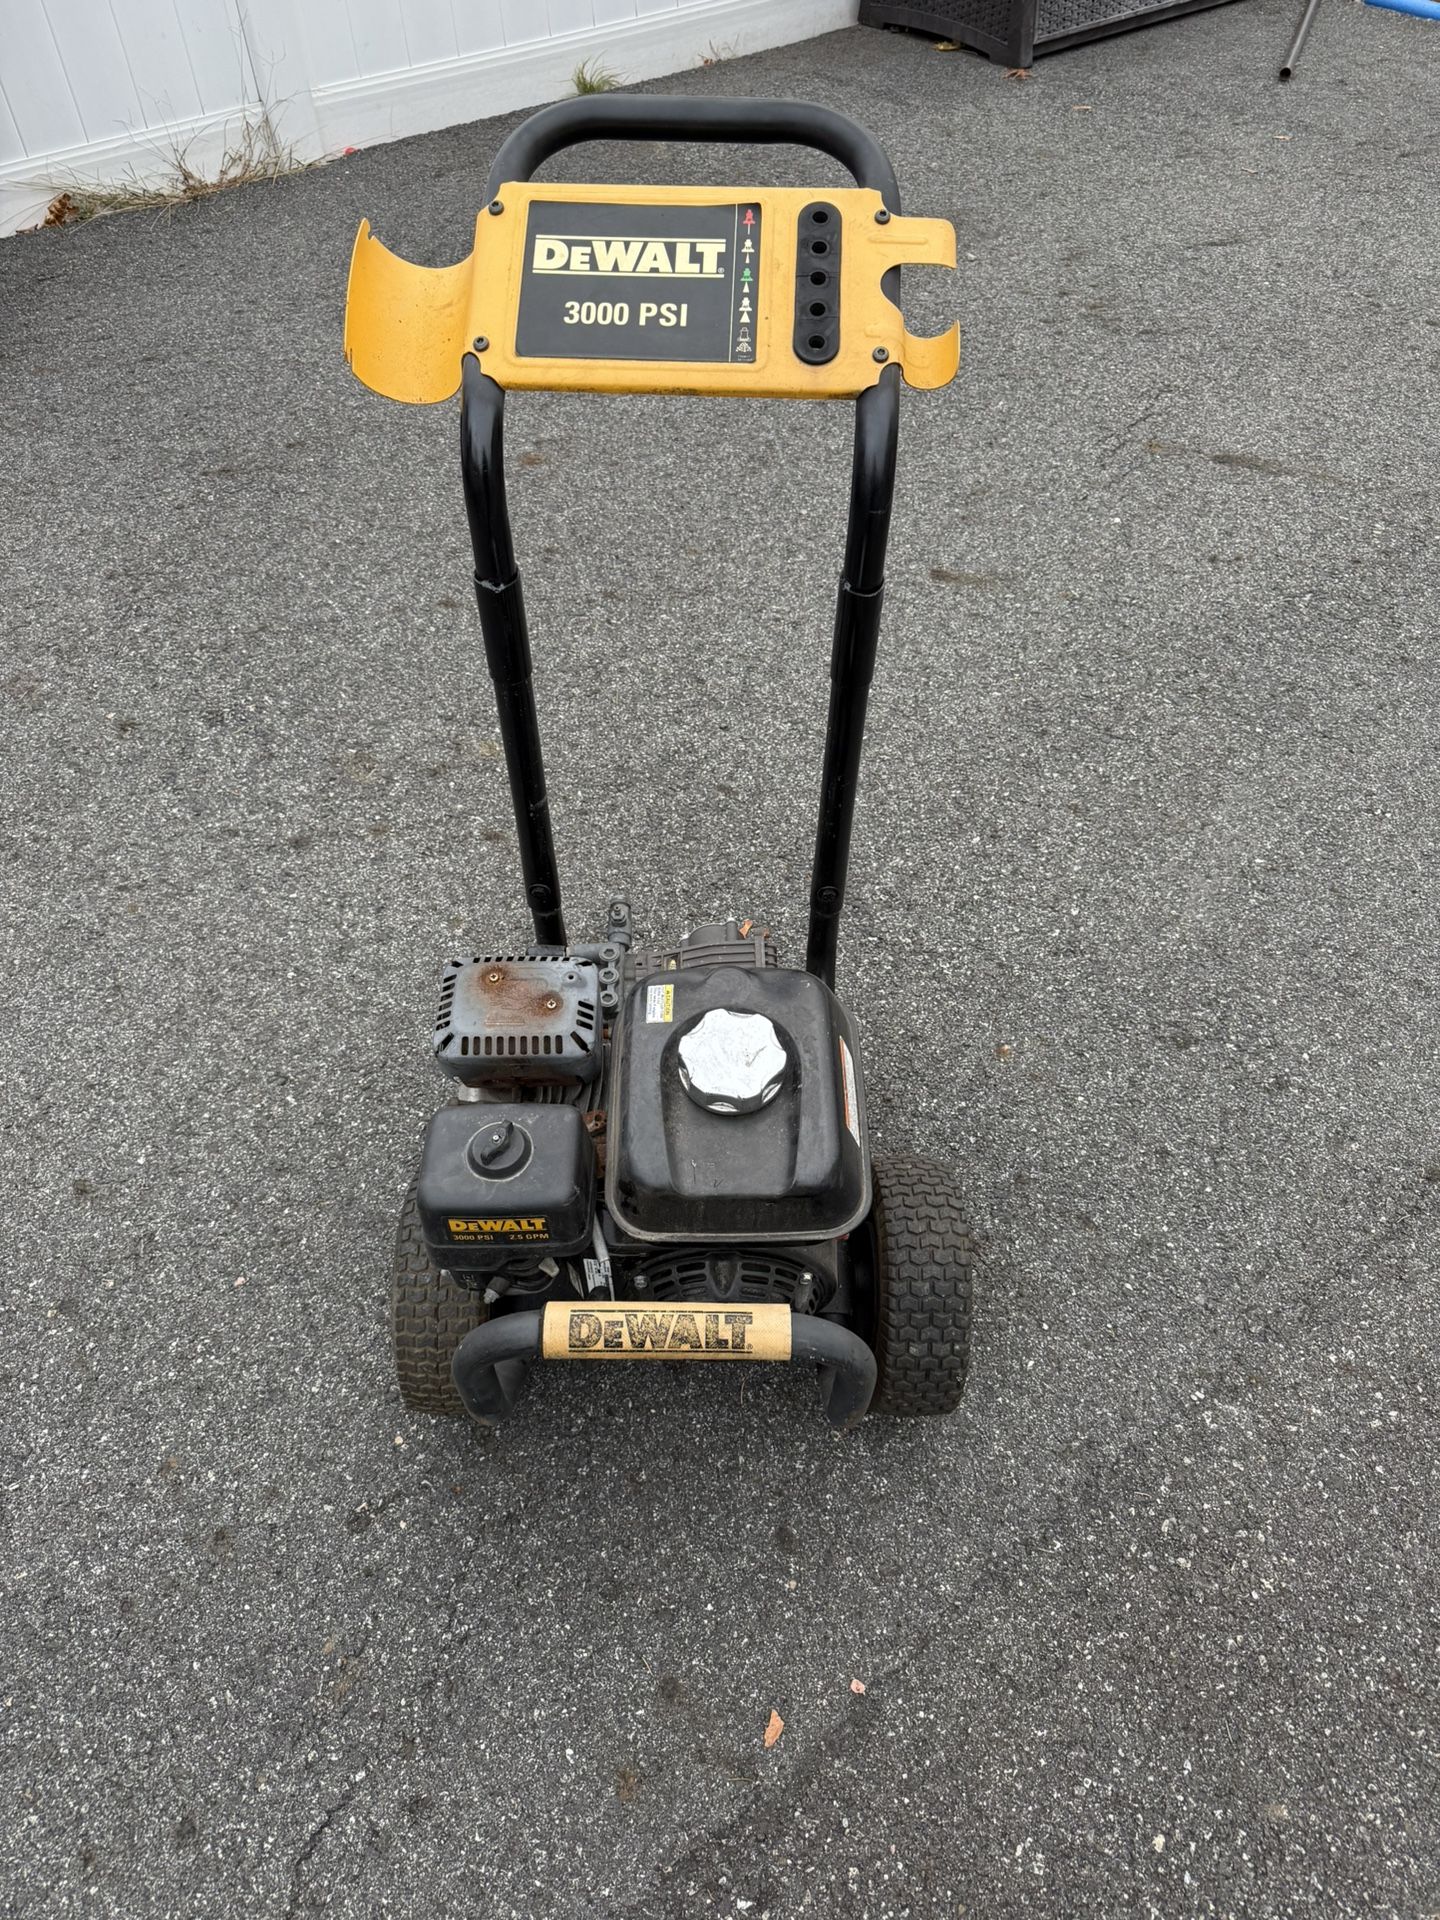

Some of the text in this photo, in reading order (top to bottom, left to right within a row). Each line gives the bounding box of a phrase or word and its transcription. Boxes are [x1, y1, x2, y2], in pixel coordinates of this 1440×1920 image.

[533, 238, 726, 274] DEWALT
[563, 301, 688, 327] 3000 PSI
[447, 1218, 546, 1233] DEWALT
[568, 1313, 753, 1350] DEWALT
